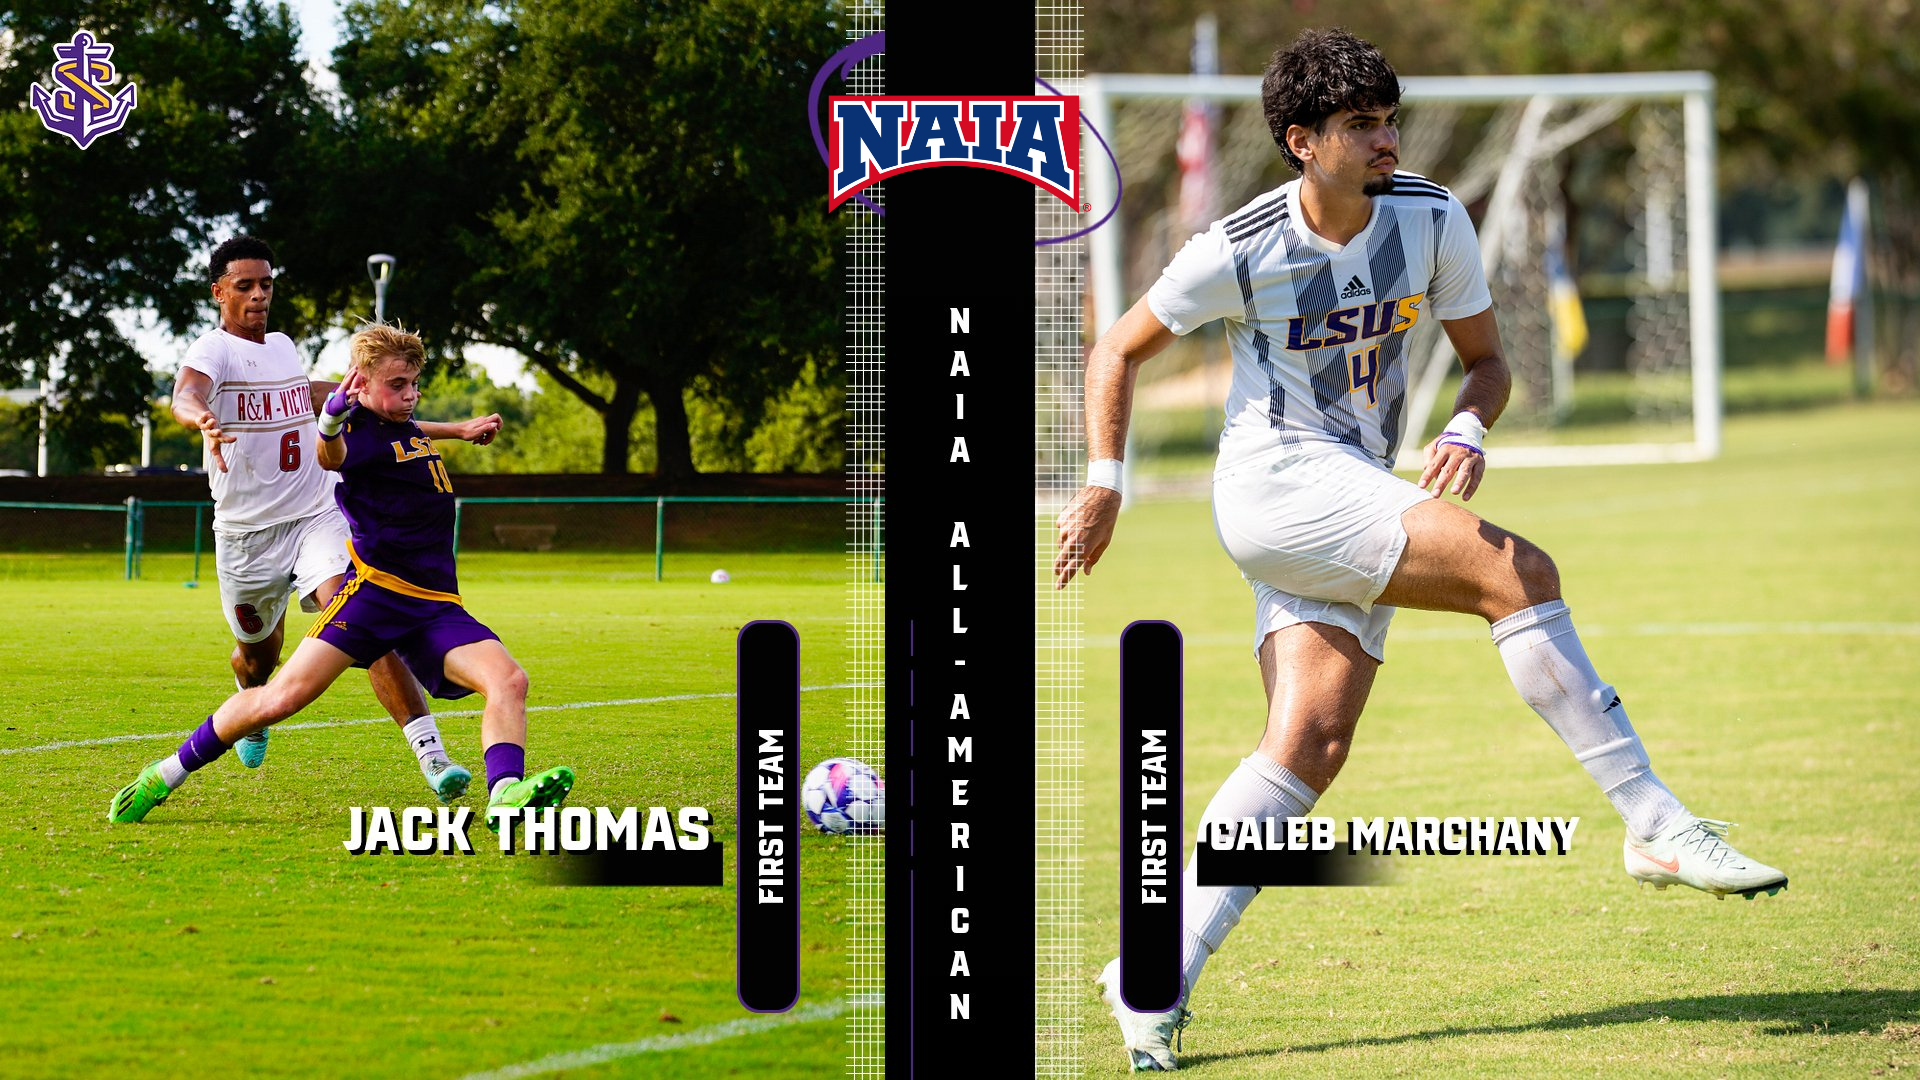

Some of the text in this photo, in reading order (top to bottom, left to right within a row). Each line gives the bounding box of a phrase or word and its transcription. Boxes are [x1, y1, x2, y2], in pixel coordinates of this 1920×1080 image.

[1340, 287, 1372, 300] adidas
[1285, 291, 1425, 351] LSUS
[1347, 344, 1381, 409] 4
[279, 429, 301, 473] 6
[427, 459, 454, 494] 10
[234, 603, 264, 635] 6
